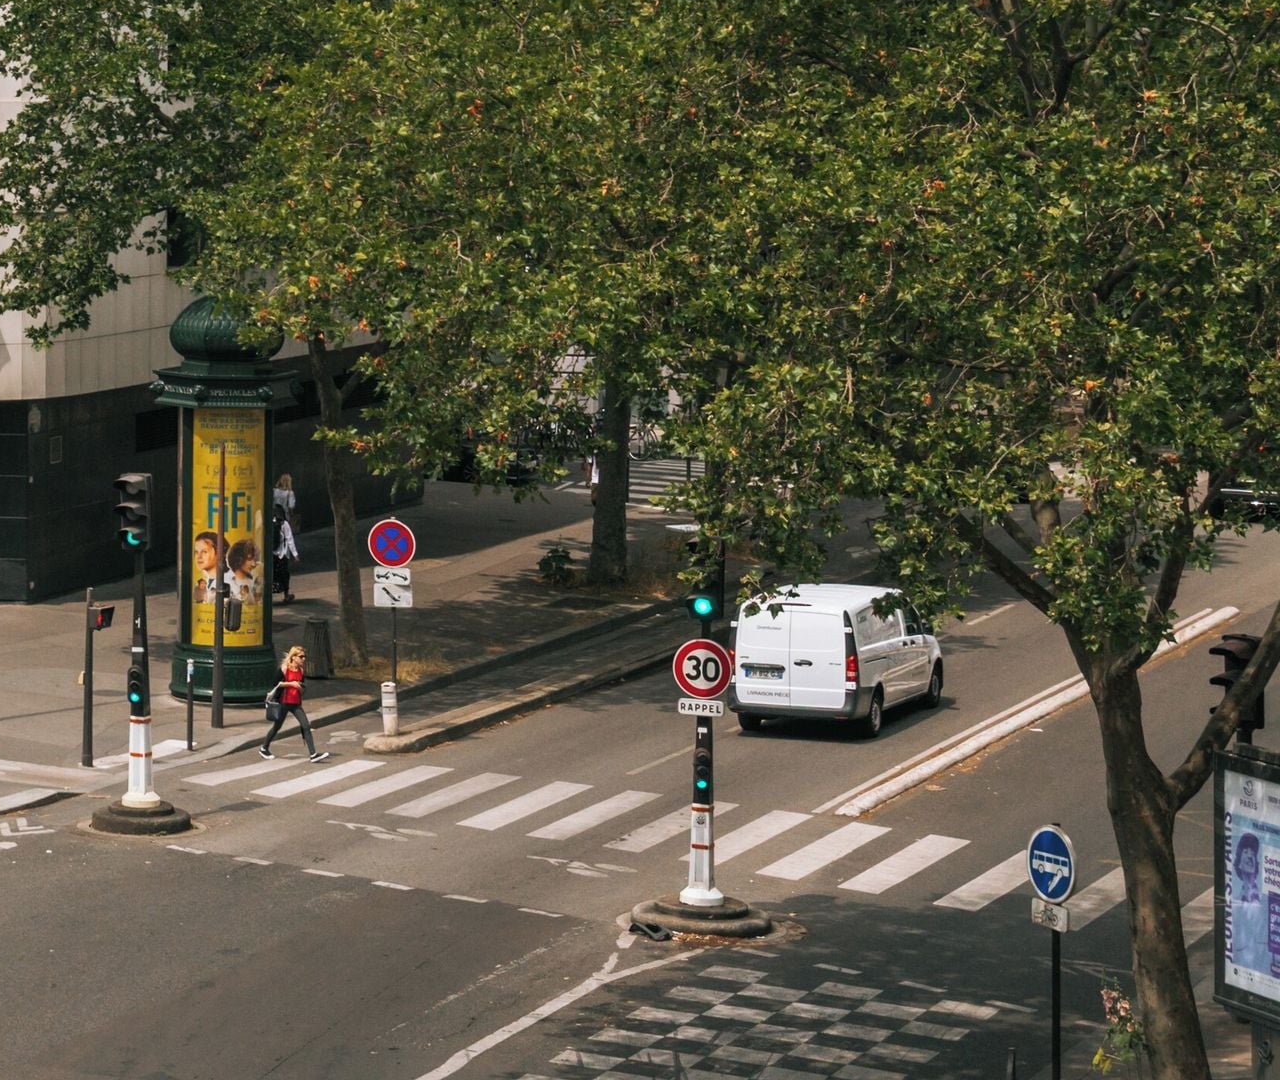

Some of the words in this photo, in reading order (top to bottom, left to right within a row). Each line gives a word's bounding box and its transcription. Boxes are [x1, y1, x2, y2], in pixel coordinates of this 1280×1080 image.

[209, 388, 257, 397] SPECTACLES
[685, 655, 721, 683] 30
[746, 689, 774, 697] LIVRAISON
[680, 702, 722, 714] RAPPEL
[1239, 798, 1258, 811] PARIS
